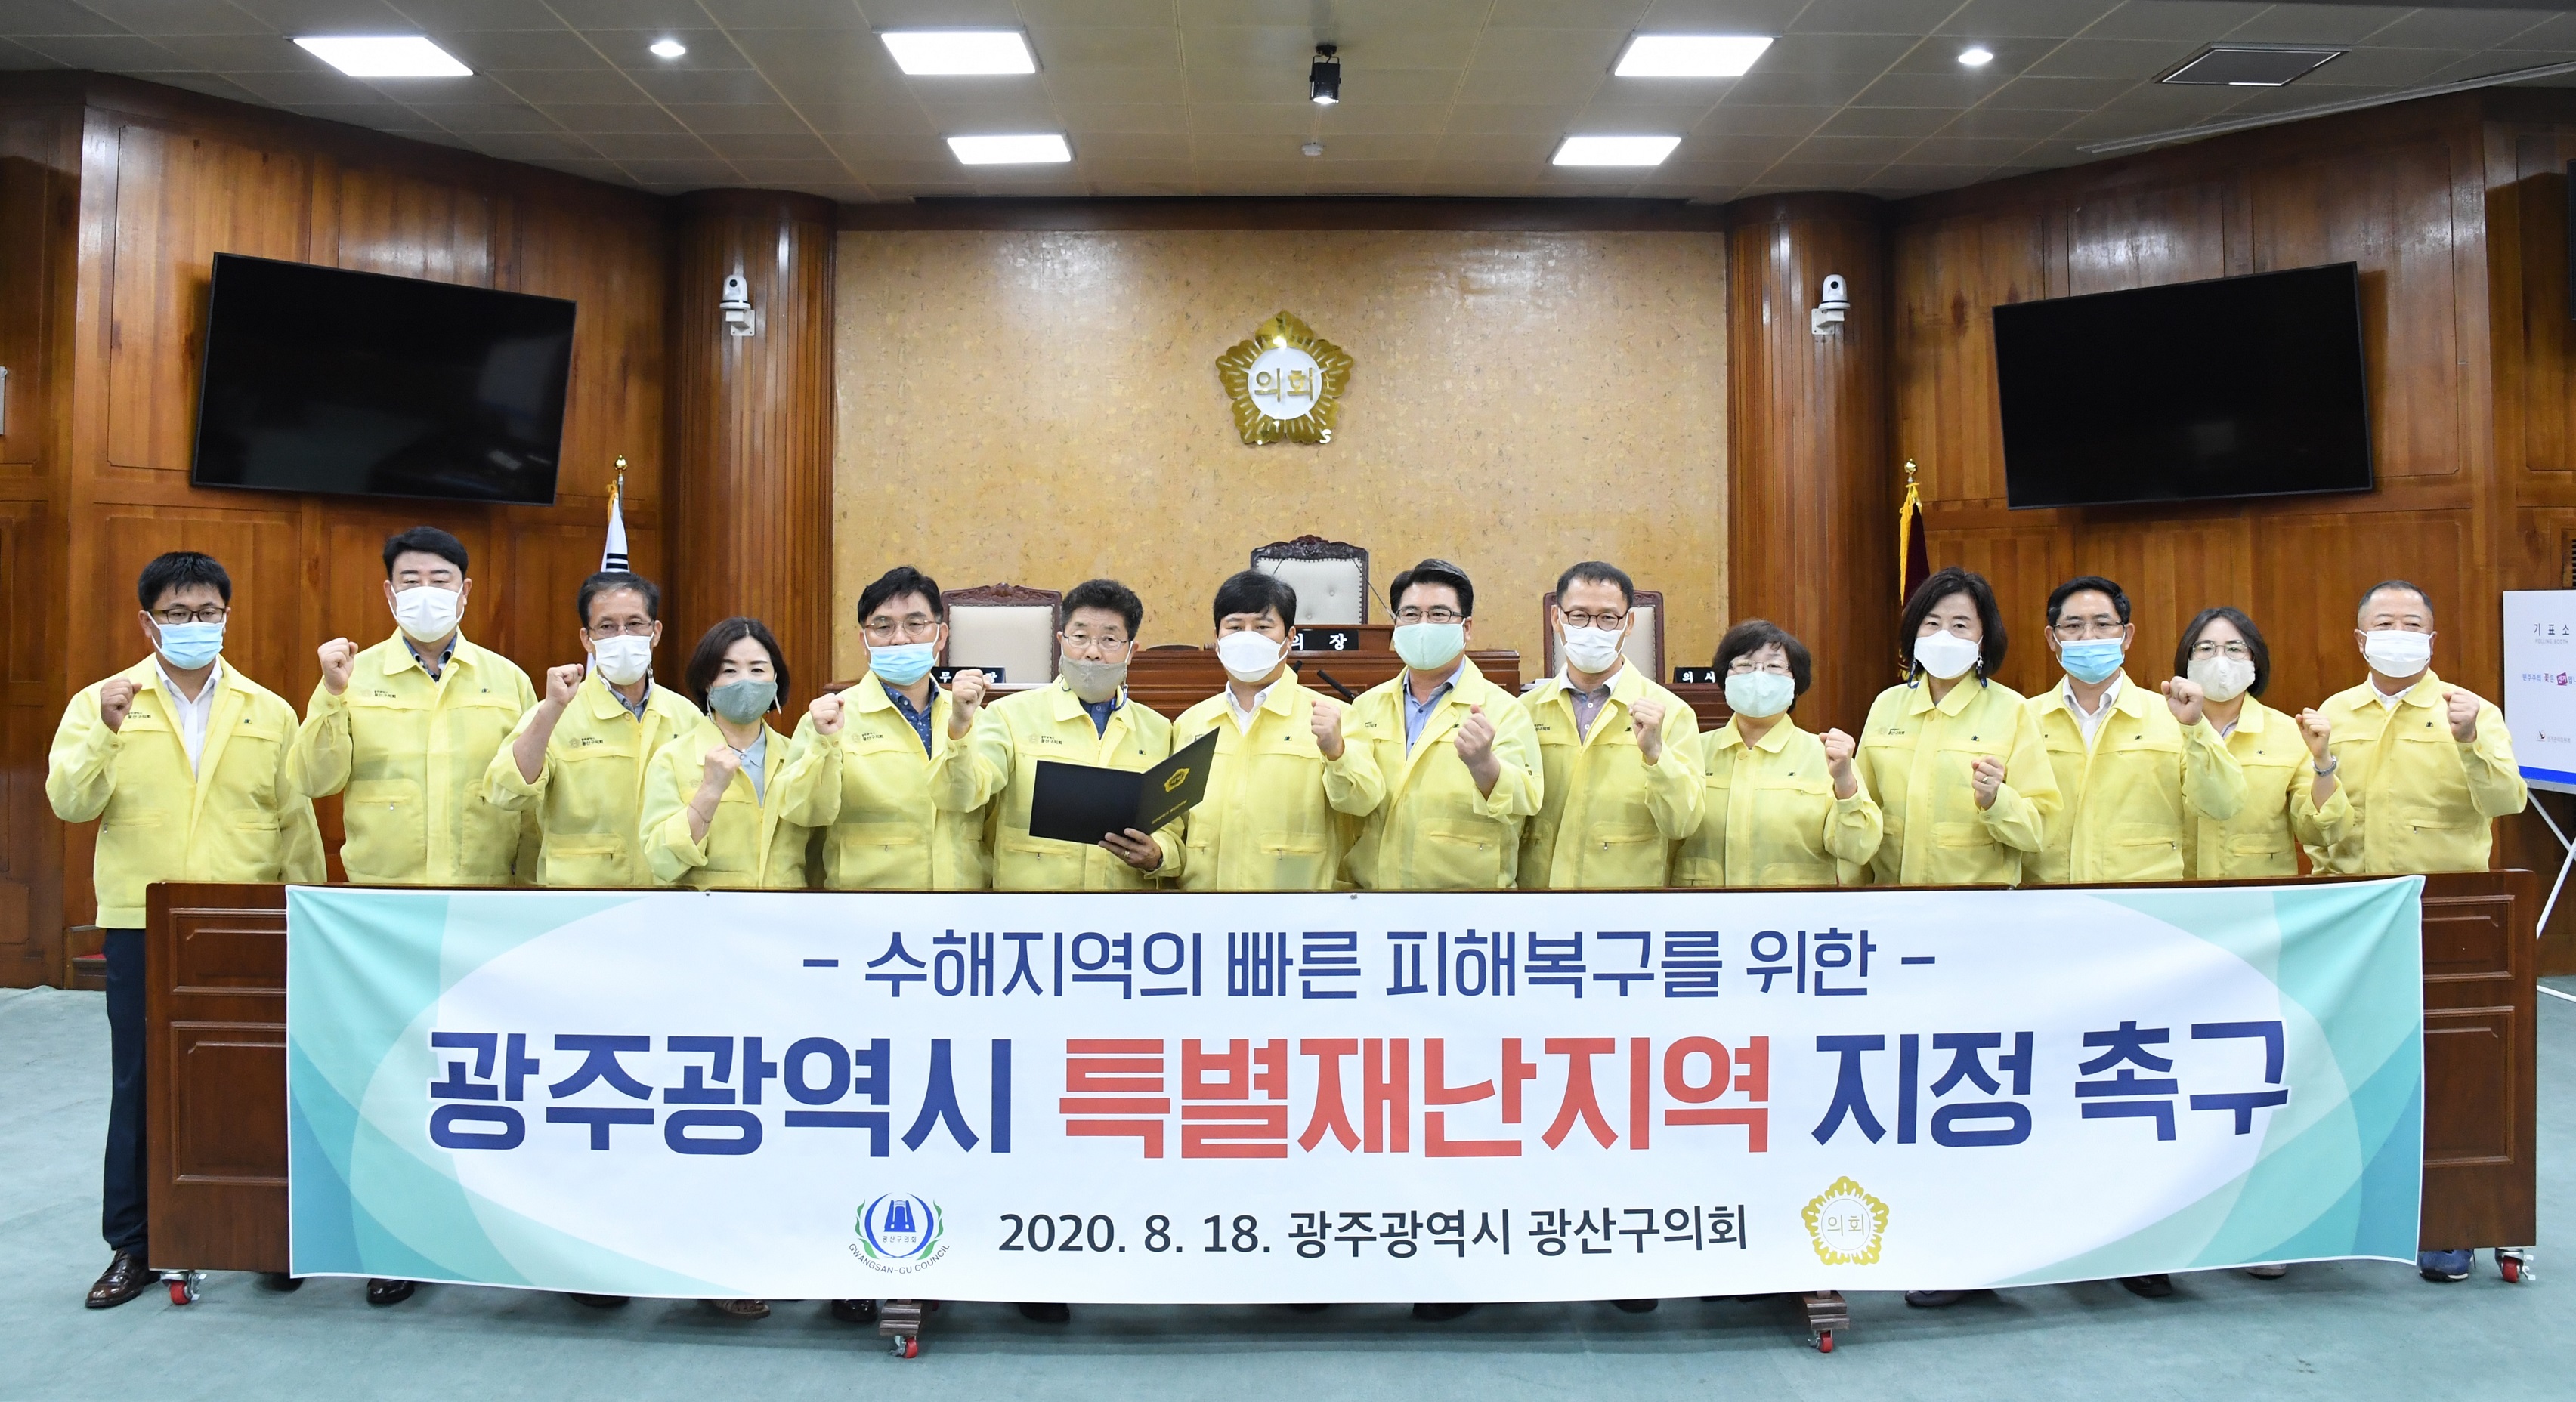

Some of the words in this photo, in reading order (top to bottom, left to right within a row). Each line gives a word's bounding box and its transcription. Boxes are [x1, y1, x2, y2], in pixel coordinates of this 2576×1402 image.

[1254, 367, 1314, 403] 의회
[865, 930, 1201, 999] 수해지역의
[1228, 932, 1360, 999] 빠른
[1387, 929, 1722, 998] 피해복구를
[1747, 928, 1876, 996] 위한
[430, 1032, 1011, 1157] 광주광역시
[1060, 1036, 1768, 1158] 특별재난지역
[1811, 1032, 2033, 1147] 지정
[2075, 1021, 2288, 1141] 촉구
[999, 1214, 1125, 1252] 2020.
[1145, 1215, 1182, 1252] 8.
[1205, 1215, 1269, 1252] 18.
[1288, 1209, 1509, 1258] 광주광역시
[1529, 1205, 1746, 1256] 광산구의회
[1827, 1214, 1864, 1237] 의회
[849, 1243, 913, 1274] GWANGSAN-GU
[914, 1244, 950, 1272] COUNCIL
